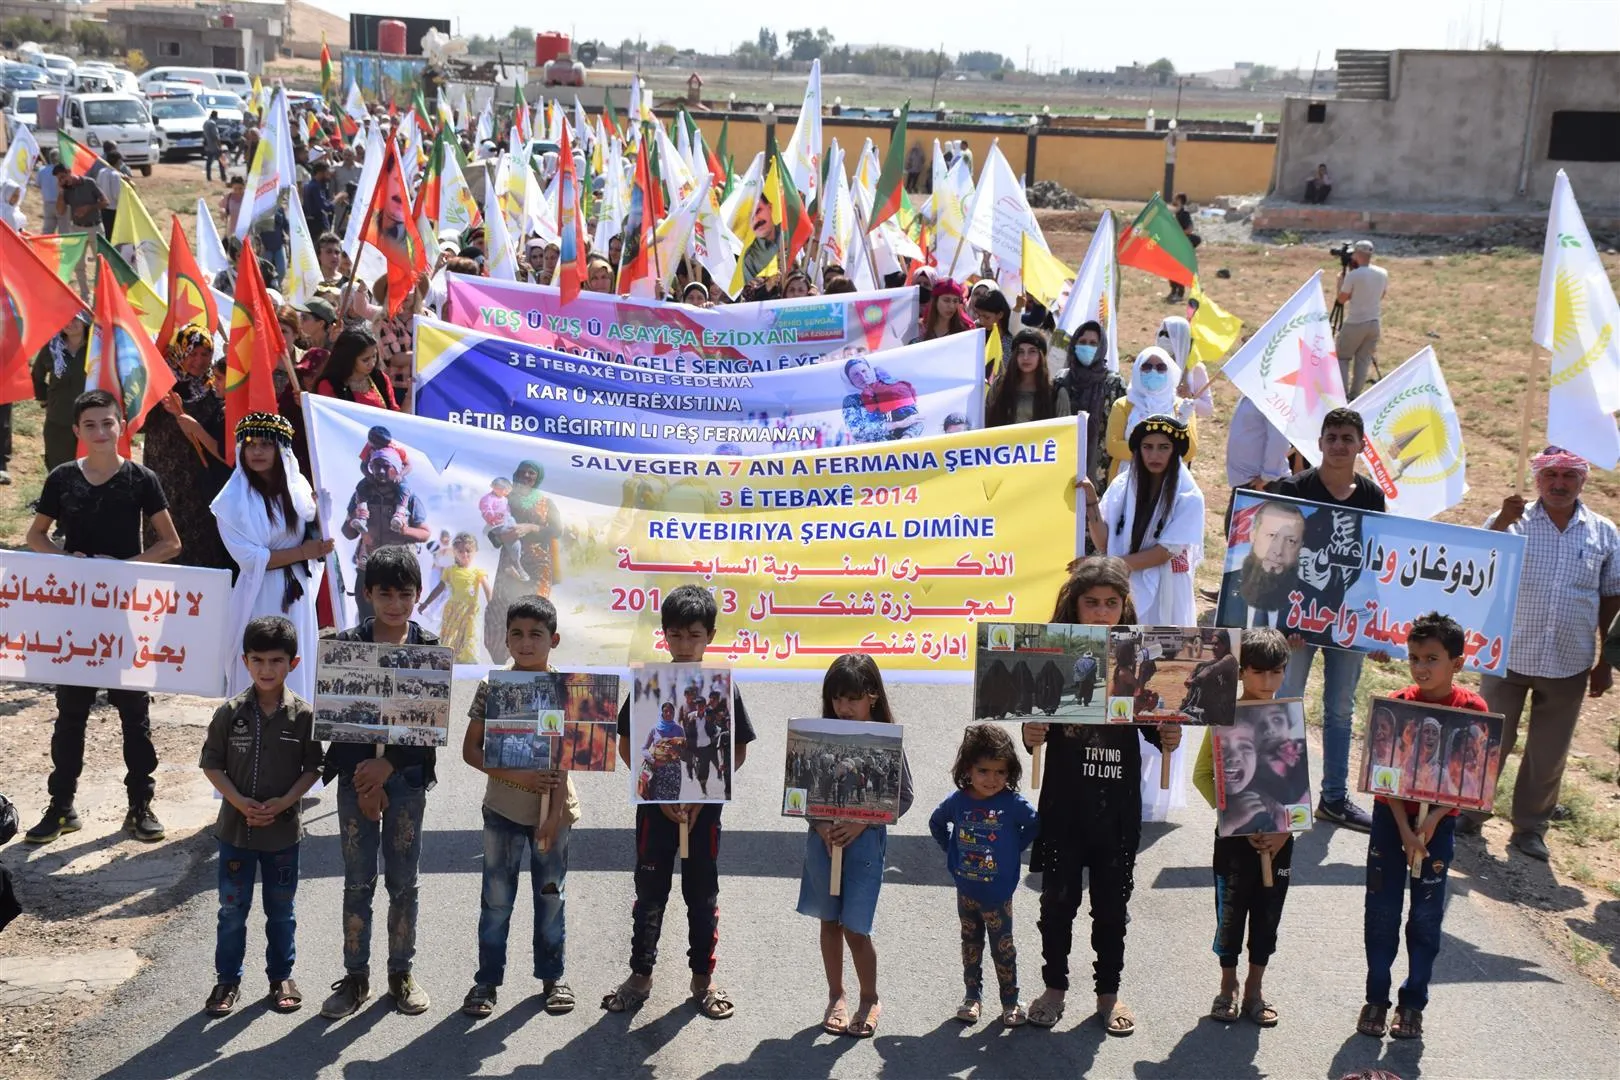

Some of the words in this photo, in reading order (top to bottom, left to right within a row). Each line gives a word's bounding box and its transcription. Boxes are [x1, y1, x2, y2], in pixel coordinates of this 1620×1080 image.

[480, 308, 522, 331] YBŞ
[527, 310, 542, 329] Û
[548, 315, 581, 337] YJŞ
[588, 318, 602, 336] Û
[608, 324, 698, 348] ASAYÎŞA
[703, 328, 798, 346] ÊZÎDXAN
[508, 352, 521, 367] 3
[526, 353, 537, 368] Ê
[540, 357, 616, 380] TEBAXÊ
[620, 371, 666, 385] DIBE
[670, 375, 753, 389] SEDEMA
[633, 353, 686, 373] GELÊ
[526, 383, 567, 401] KAR
[573, 386, 587, 403] Û
[592, 390, 742, 412] XWERÊXISTINA
[511, 415, 540, 433] BO
[544, 415, 637, 437] RÊGIRTIN
[641, 423, 658, 438] LI
[663, 423, 699, 443] PÊŞ
[703, 426, 816, 443] FERMANAN
[571, 454, 698, 476] SALVEGER
[705, 461, 721, 476] A
[728, 461, 742, 476] 7
[749, 461, 784, 476] AN
[792, 459, 808, 475] A
[815, 452, 938, 475] FERMANA
[945, 440, 1057, 472] ŞENGALÊ
[720, 490, 733, 506] 3
[741, 487, 754, 507] Ê
[758, 485, 854, 507] TEBAXÊ
[860, 487, 918, 506] 2014
[649, 517, 793, 541] RÊVEBIRIYA
[801, 521, 898, 544] ŞENGAL
[904, 514, 994, 538] DIMÎNE
[1400, 545, 1497, 597] أردوغان
[0, 573, 86, 609] العثماني
[186, 591, 204, 617] لا
[611, 588, 660, 612] 201
[722, 590, 738, 613] 3
[133, 635, 186, 672] بحق
[1085, 747, 1121, 762] TRYING
[1083, 763, 1096, 777] TO
[1098, 764, 1122, 779] LOVE
